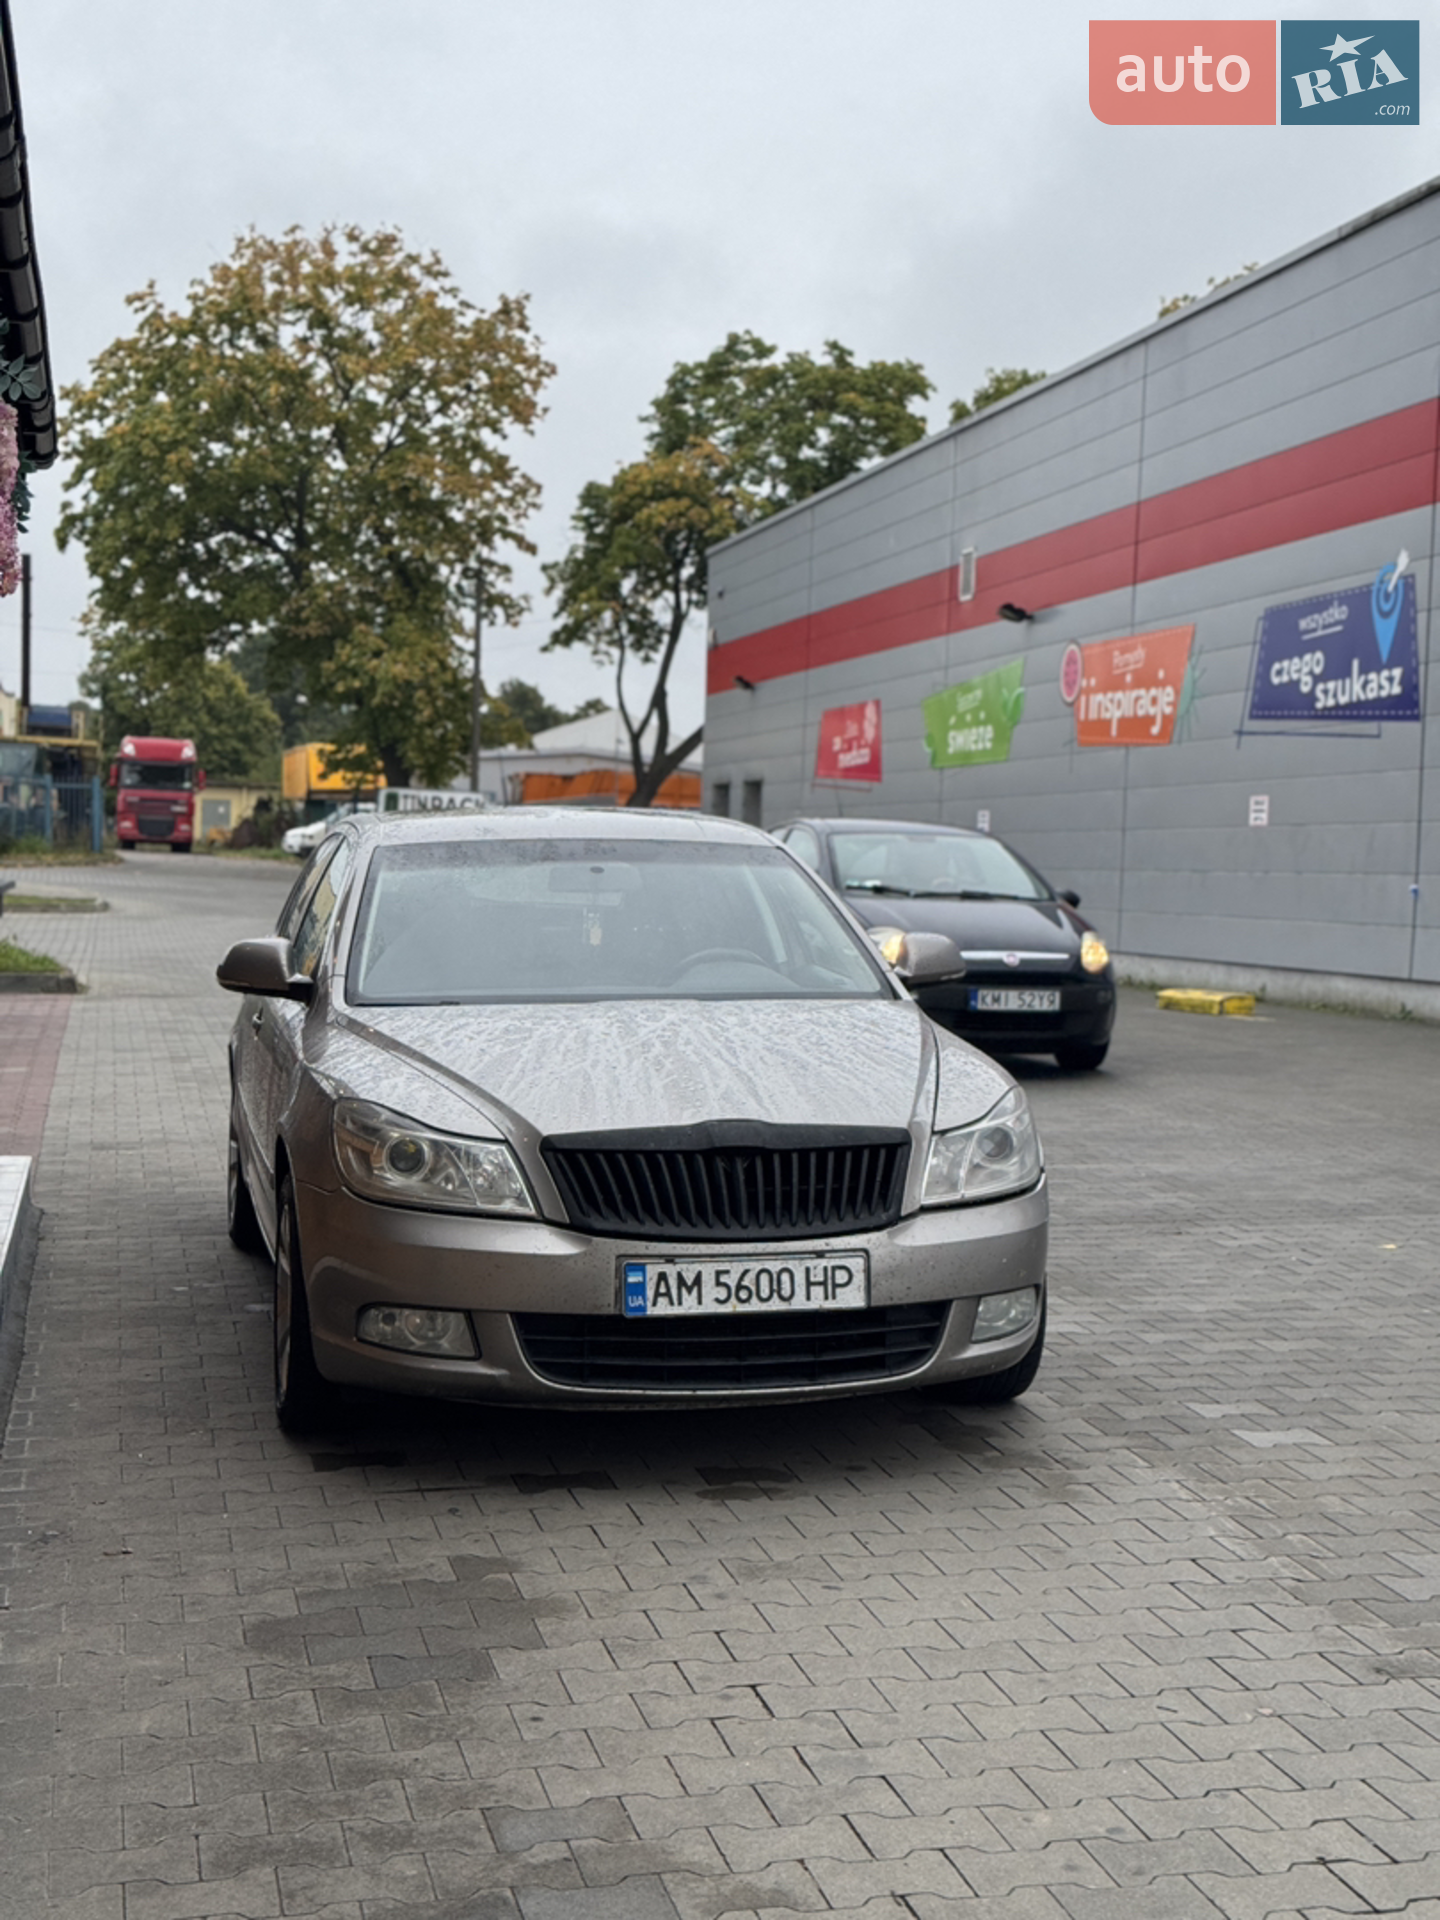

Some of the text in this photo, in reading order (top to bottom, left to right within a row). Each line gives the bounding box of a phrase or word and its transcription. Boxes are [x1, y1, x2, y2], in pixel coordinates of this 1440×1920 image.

[1270, 650, 1325, 693] czego
[1314, 657, 1403, 710] szukasz
[628, 1295, 645, 1307] UA
[651, 1264, 854, 1308] AM 5600 HP
